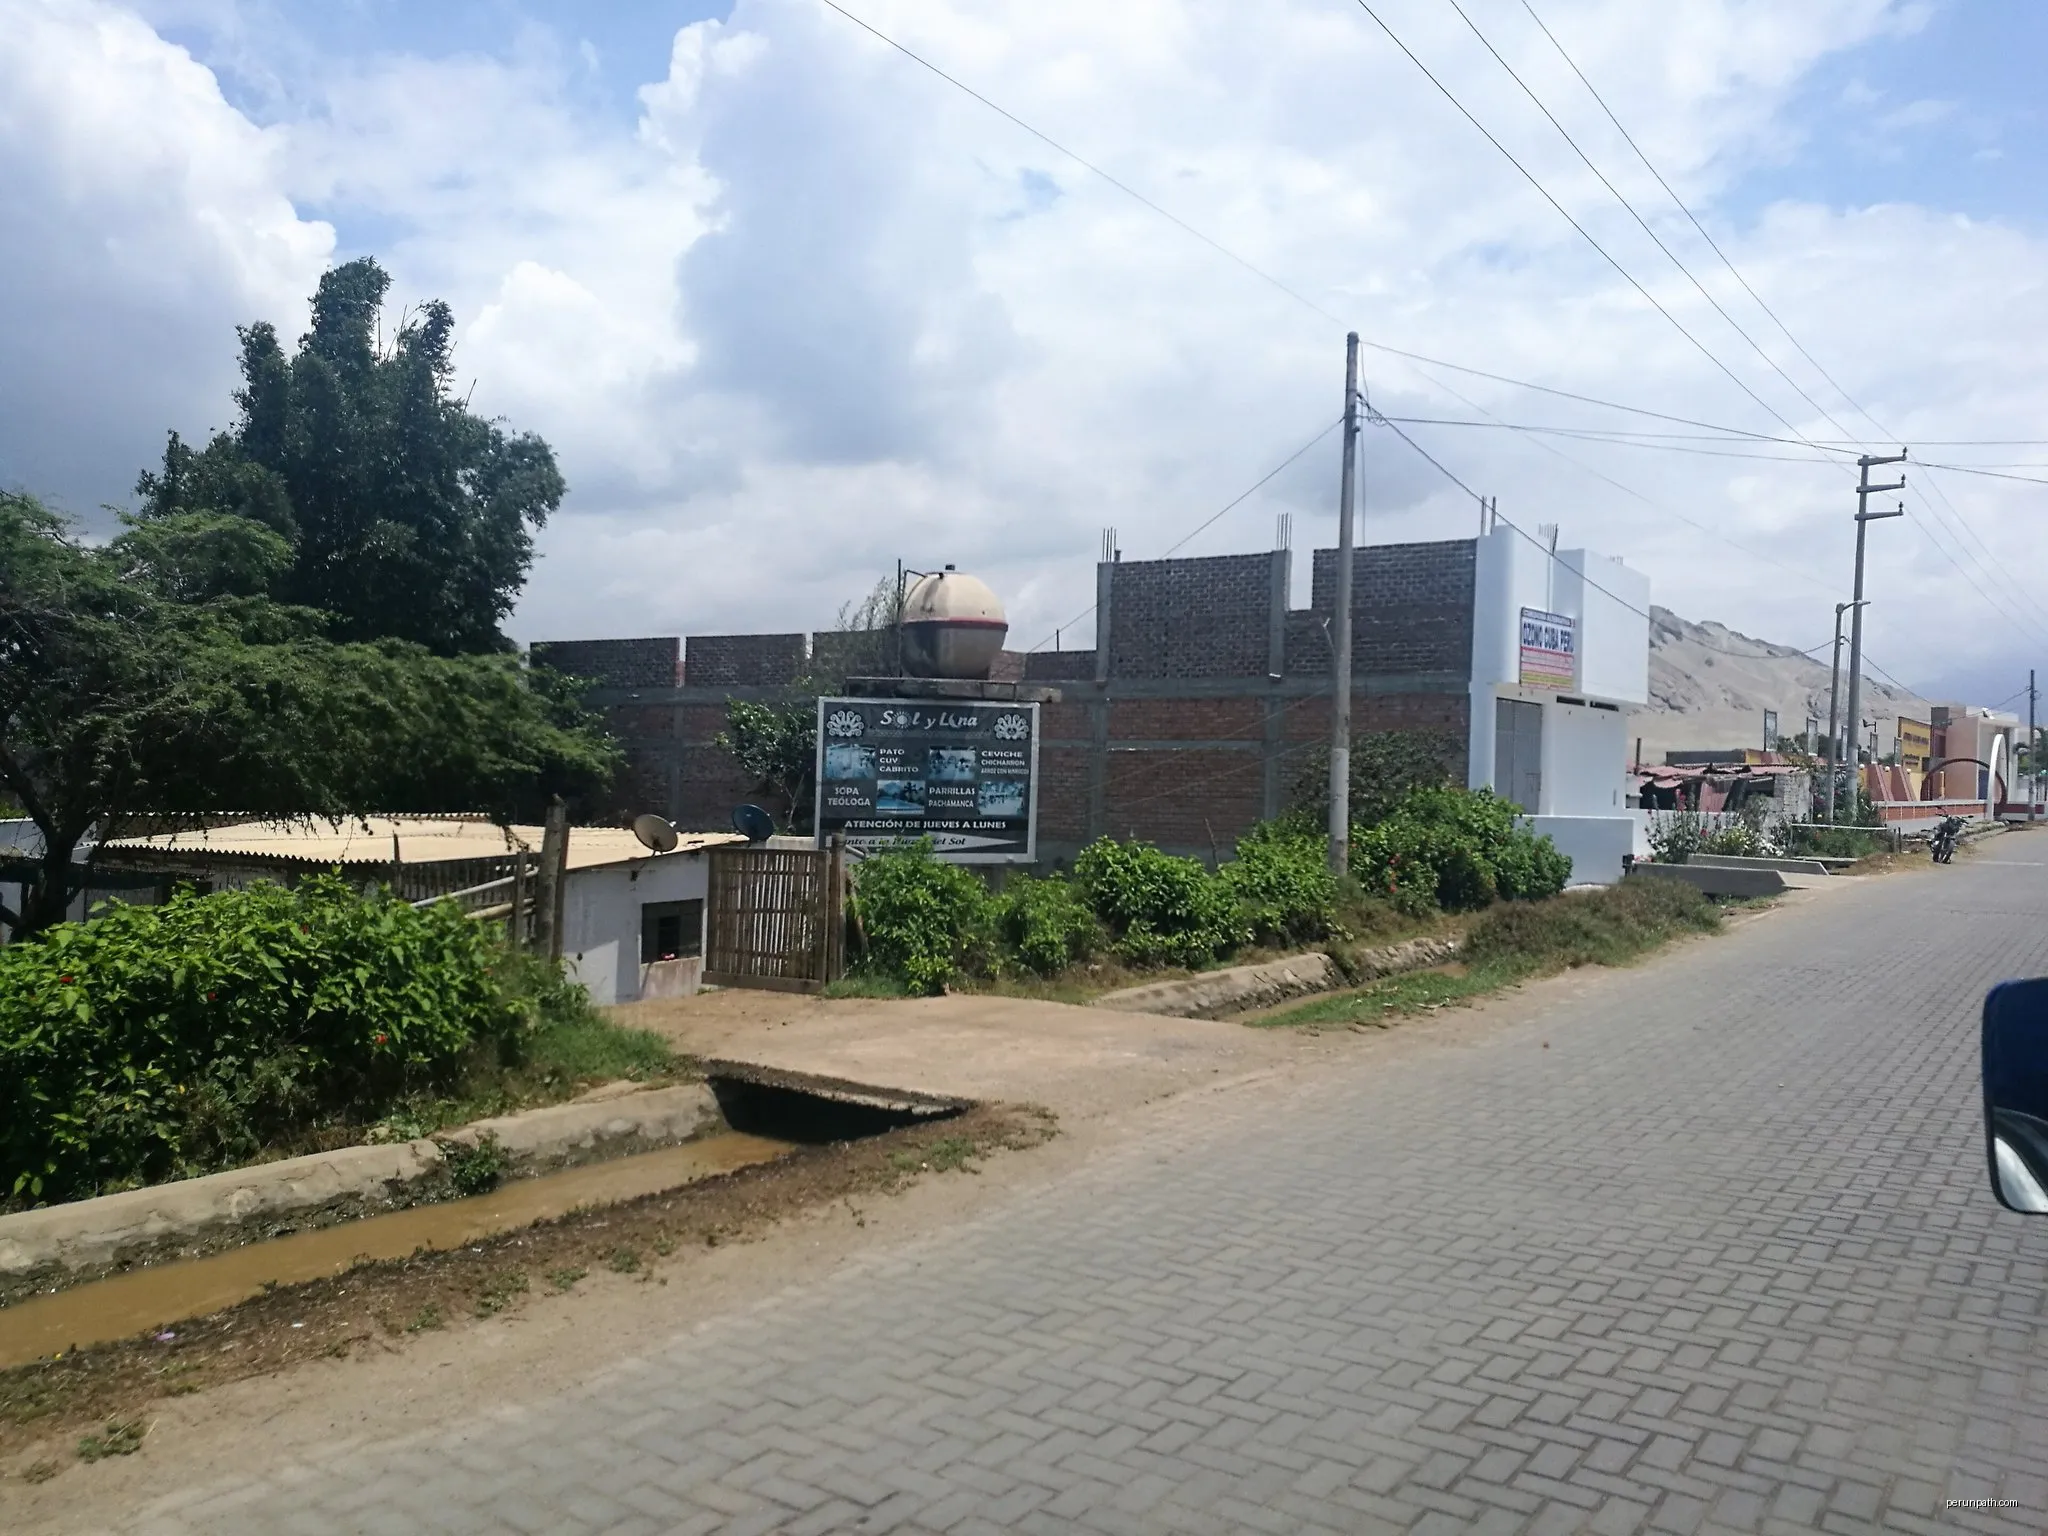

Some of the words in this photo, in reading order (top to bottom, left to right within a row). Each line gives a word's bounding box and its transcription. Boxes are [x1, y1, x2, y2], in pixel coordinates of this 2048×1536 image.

[924, 718, 936, 730] y
[981, 750, 1024, 758] CEVICHE
[879, 765, 920, 773] CABRITO
[835, 786, 860, 796] SOPA
[929, 786, 976, 796] PARRILLAS
[827, 795, 871, 806] TEÓLOGA
[928, 799, 975, 808] PACHAMANCA
[844, 819, 903, 829] ATENCIÓN
[905, 820, 920, 828] DE
[923, 820, 960, 829] JUEVES
[962, 820, 971, 829] A
[973, 820, 1007, 829] LUNES
[949, 837, 967, 846] Sol
